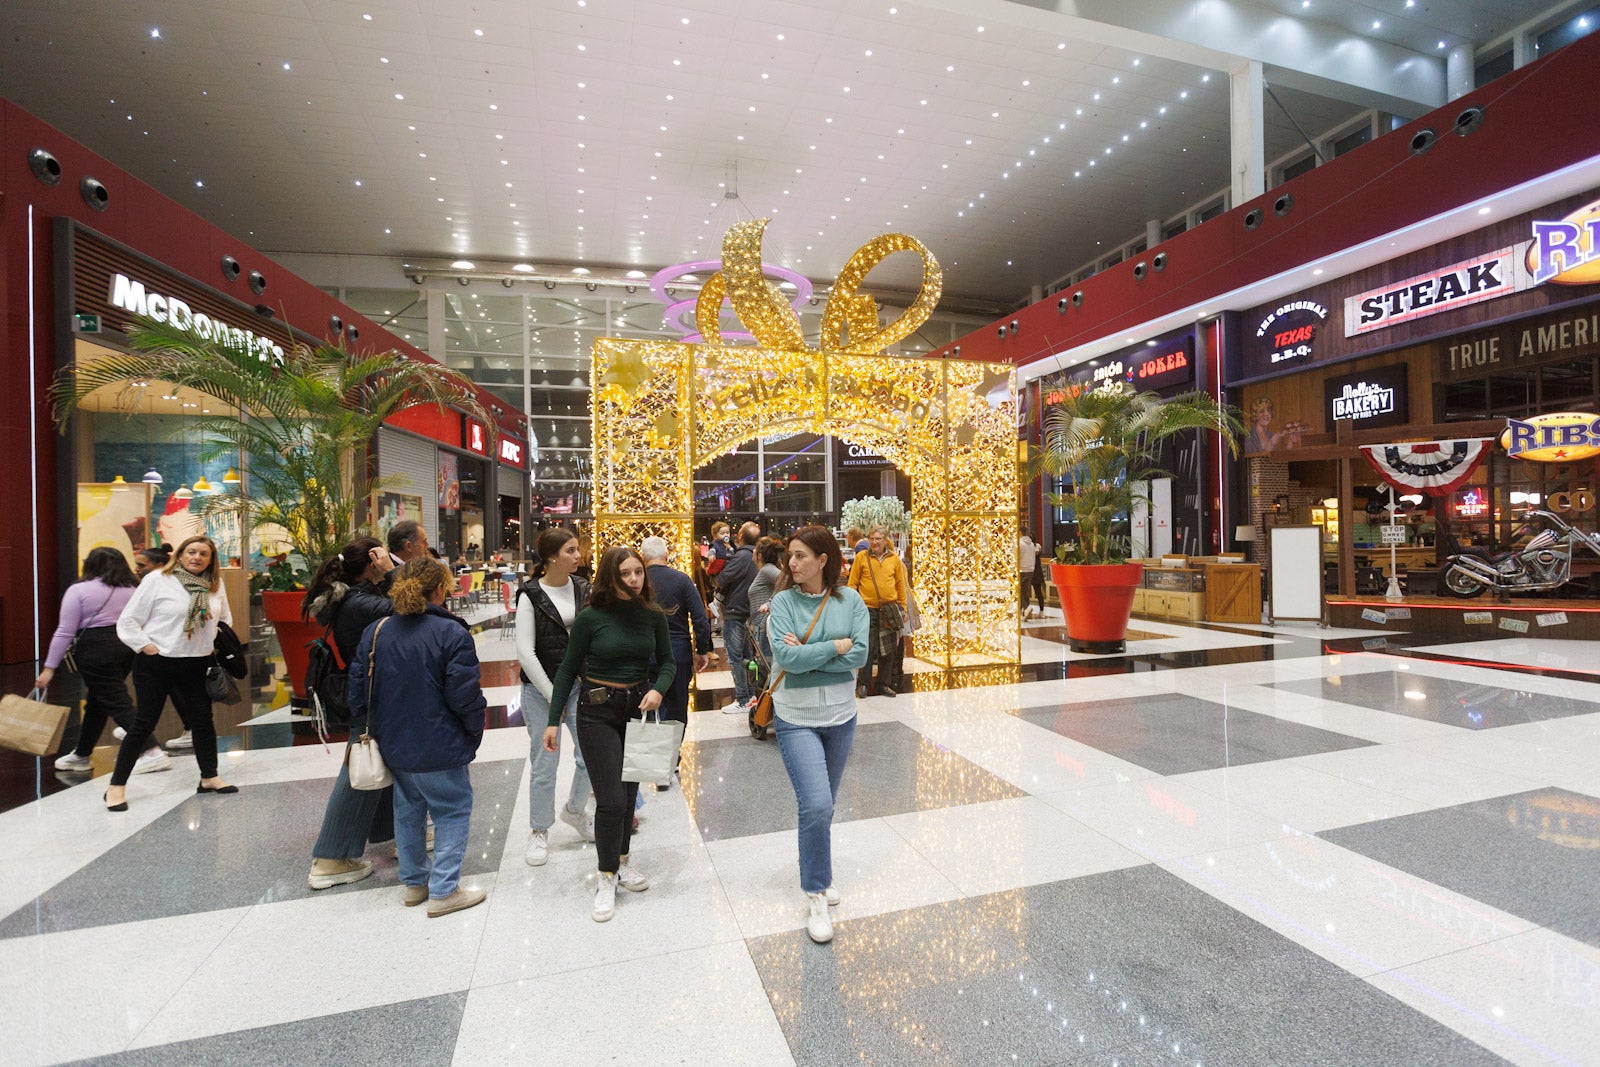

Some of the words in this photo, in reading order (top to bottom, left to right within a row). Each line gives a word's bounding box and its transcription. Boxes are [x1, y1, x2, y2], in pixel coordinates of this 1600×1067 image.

[1360, 259, 1502, 324] STEAK
[1256, 312, 1276, 337] THE
[1277, 301, 1328, 319] ORIGINAL
[1274, 324, 1313, 348] TEXAS
[1138, 351, 1187, 379] JOKER
[1271, 345, 1312, 363] B.B.Q.
[1449, 337, 1500, 371] TRUE
[1336, 393, 1389, 416] BAKERY
[501, 440, 520, 463] KFC
